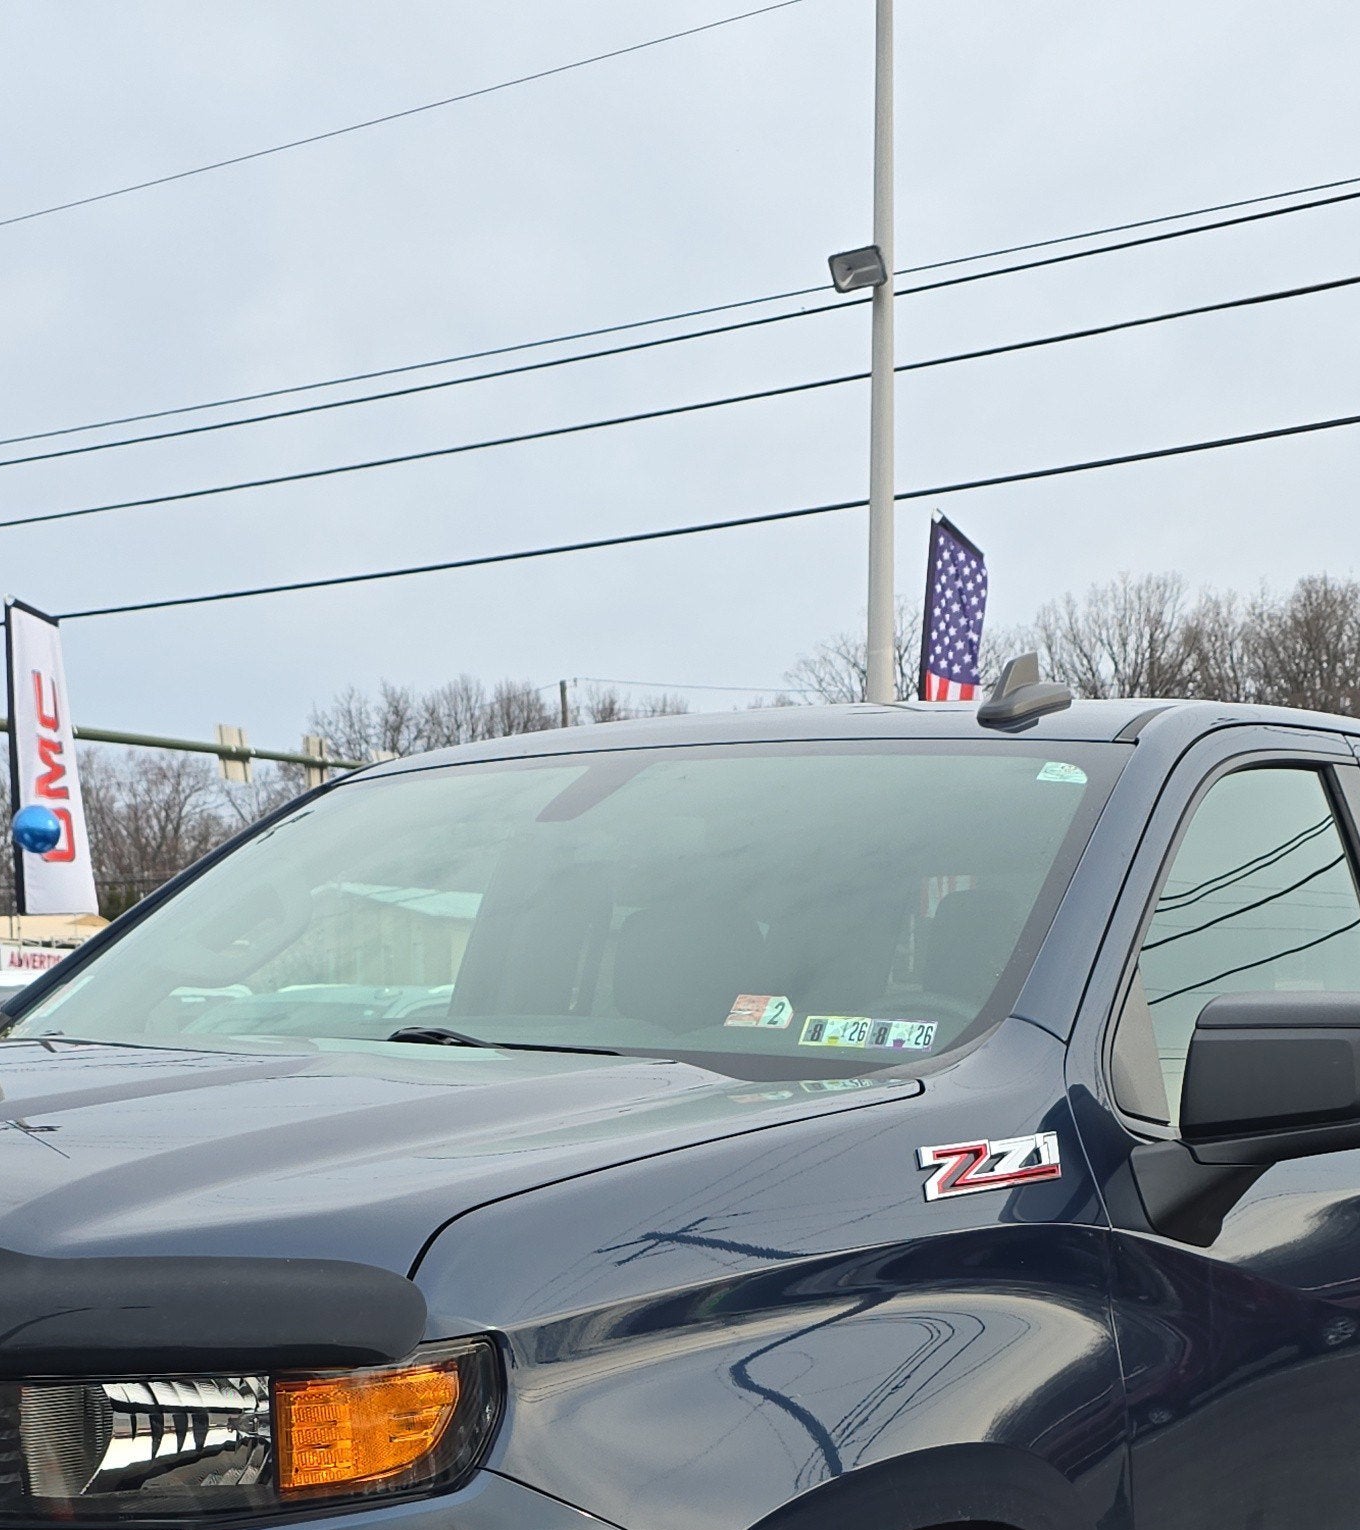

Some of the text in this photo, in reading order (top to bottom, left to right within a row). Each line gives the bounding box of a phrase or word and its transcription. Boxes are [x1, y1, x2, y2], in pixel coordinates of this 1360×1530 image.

[767, 1001, 786, 1026] 2
[848, 1021, 869, 1042] 26
[914, 1025, 934, 1047] 26
[915, 1130, 1062, 1202] Z71
